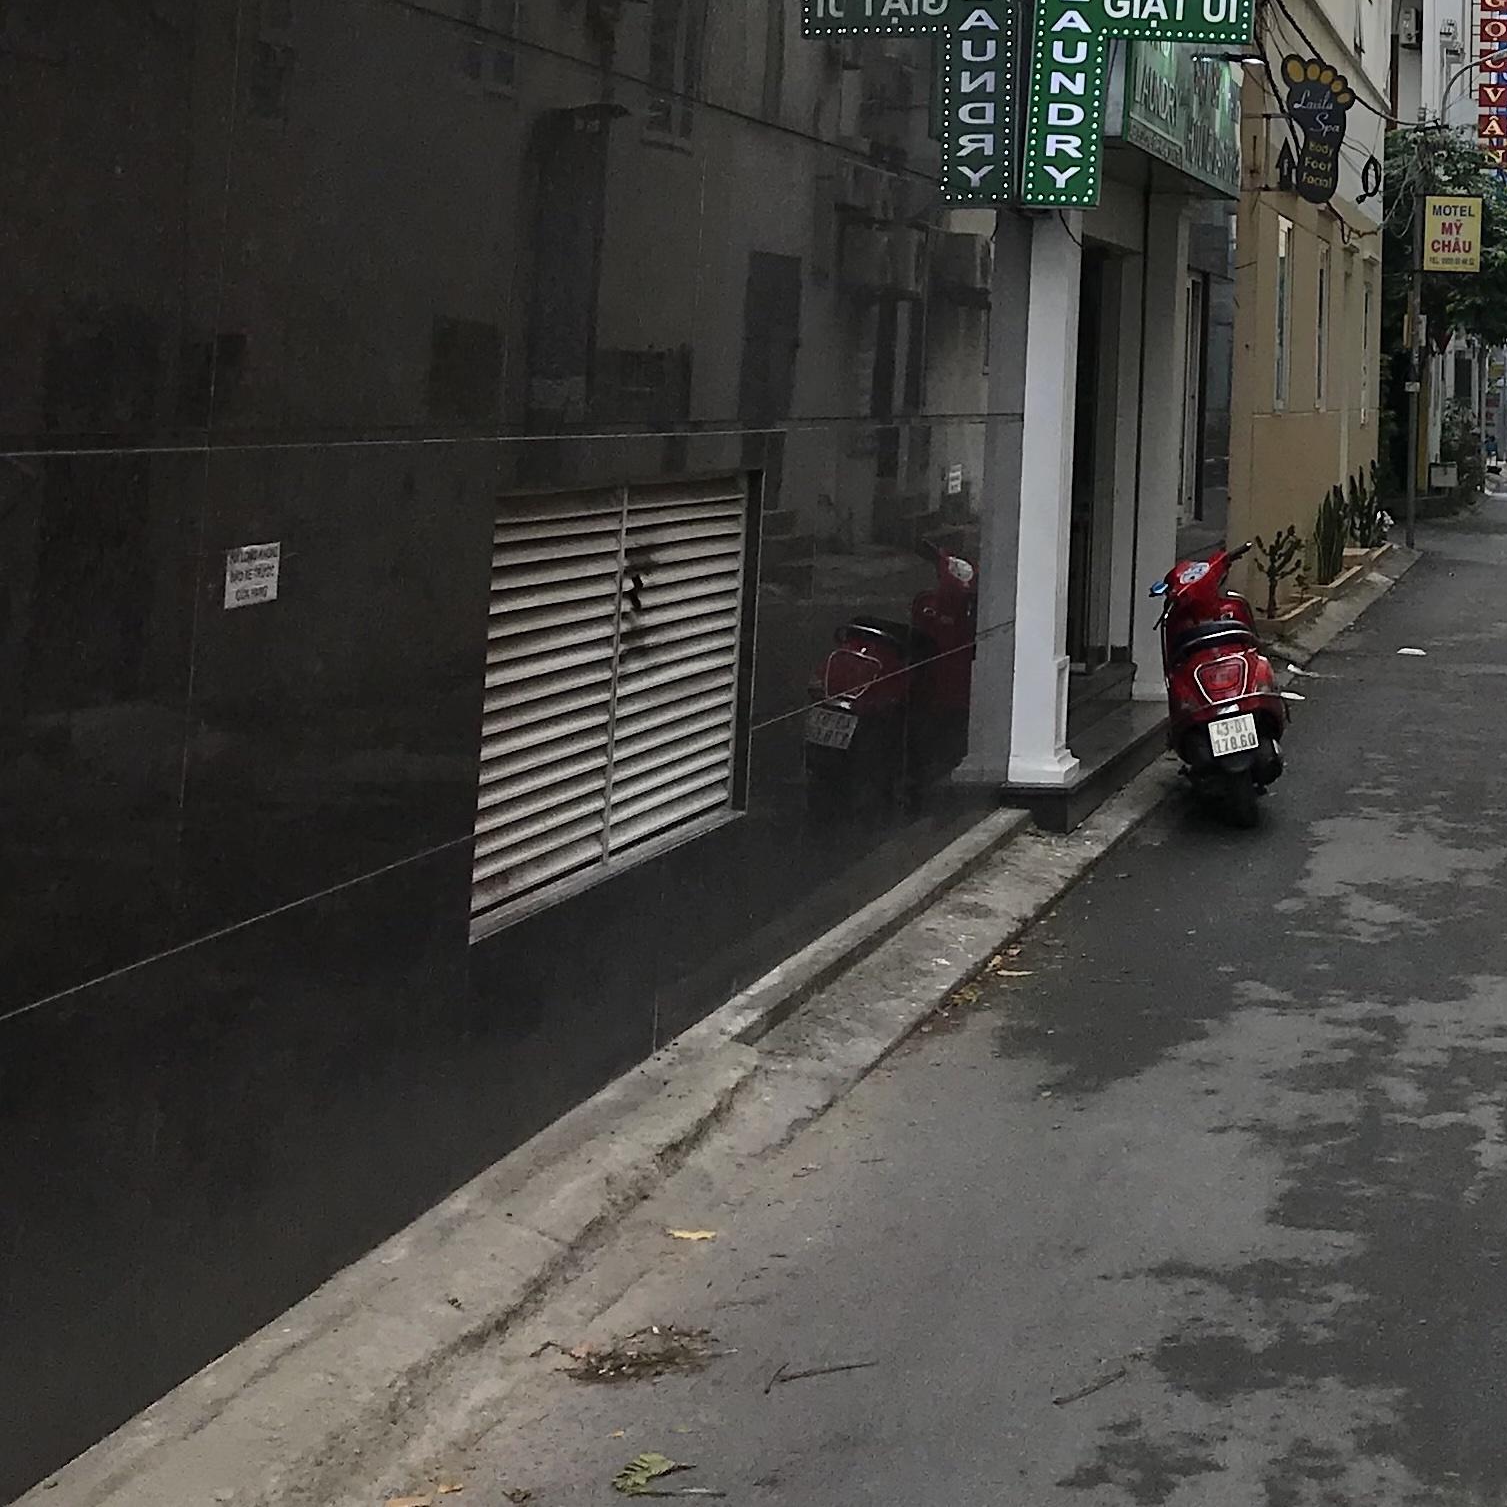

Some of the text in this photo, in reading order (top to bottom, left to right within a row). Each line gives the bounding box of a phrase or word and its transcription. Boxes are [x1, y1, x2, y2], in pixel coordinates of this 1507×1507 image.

[1310, 112, 1340, 137] Spa
[1305, 157, 1332, 171] Foot
[1433, 205, 1475, 217] MOTEL
[1441, 219, 1463, 236] MỸ
[1431, 237, 1472, 253] CHÂU
[1214, 732, 1256, 754] 178.60
